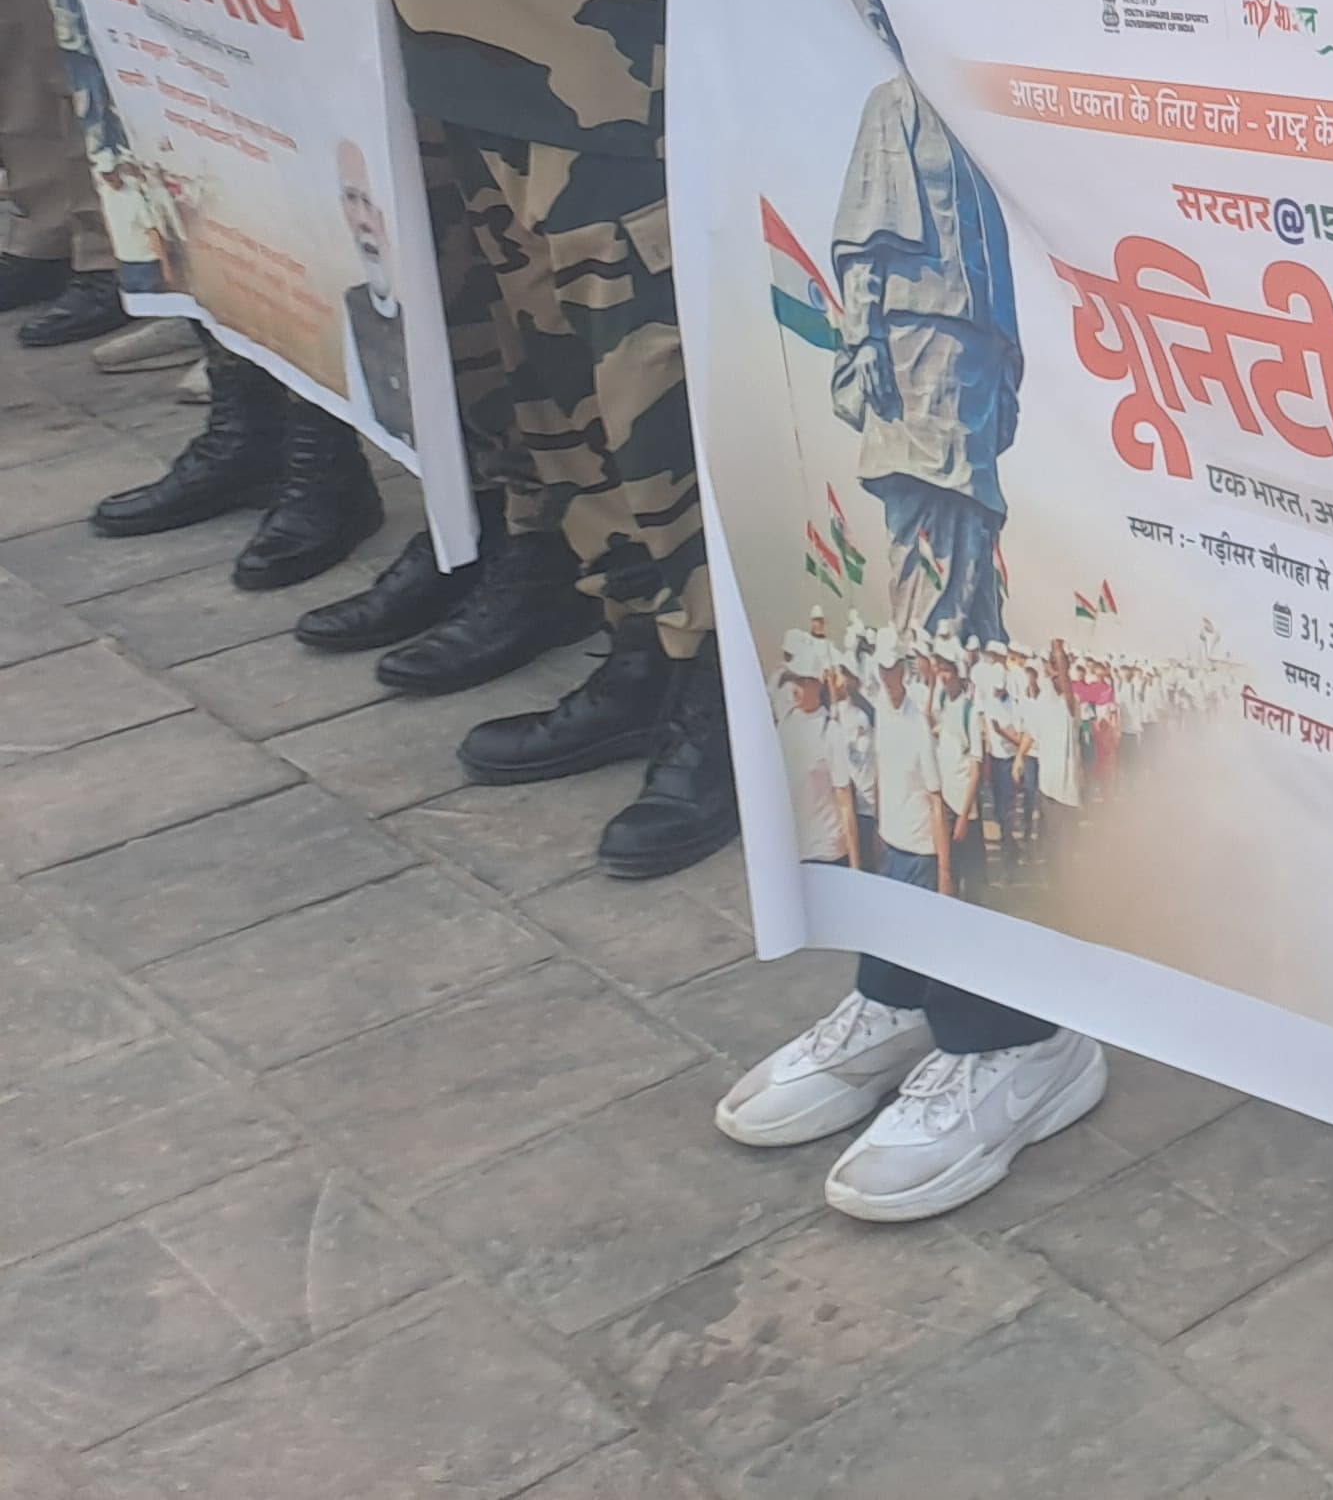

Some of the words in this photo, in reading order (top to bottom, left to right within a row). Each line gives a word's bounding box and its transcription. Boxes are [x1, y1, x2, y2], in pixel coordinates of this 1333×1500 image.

[1009, 78, 1064, 117] आइए,
[1068, 87, 1125, 121] एकता
[1129, 84, 1150, 123] के
[1154, 88, 1198, 130] लिए
[1203, 94, 1241, 134] चलें
[1266, 109, 1309, 152] राष्ट्र
[1206, 463, 1247, 498] एक
[1249, 477, 1311, 524] भारत,
[1127, 516, 1174, 546] स्थान
[1199, 531, 1256, 569] गड़ीसर
[1259, 542, 1311, 587] चौराहा
[1314, 558, 1331, 591] से
[1299, 613, 1325, 651] 31,
[1282, 661, 1321, 693] समय
[1241, 684, 1295, 736] जिला
